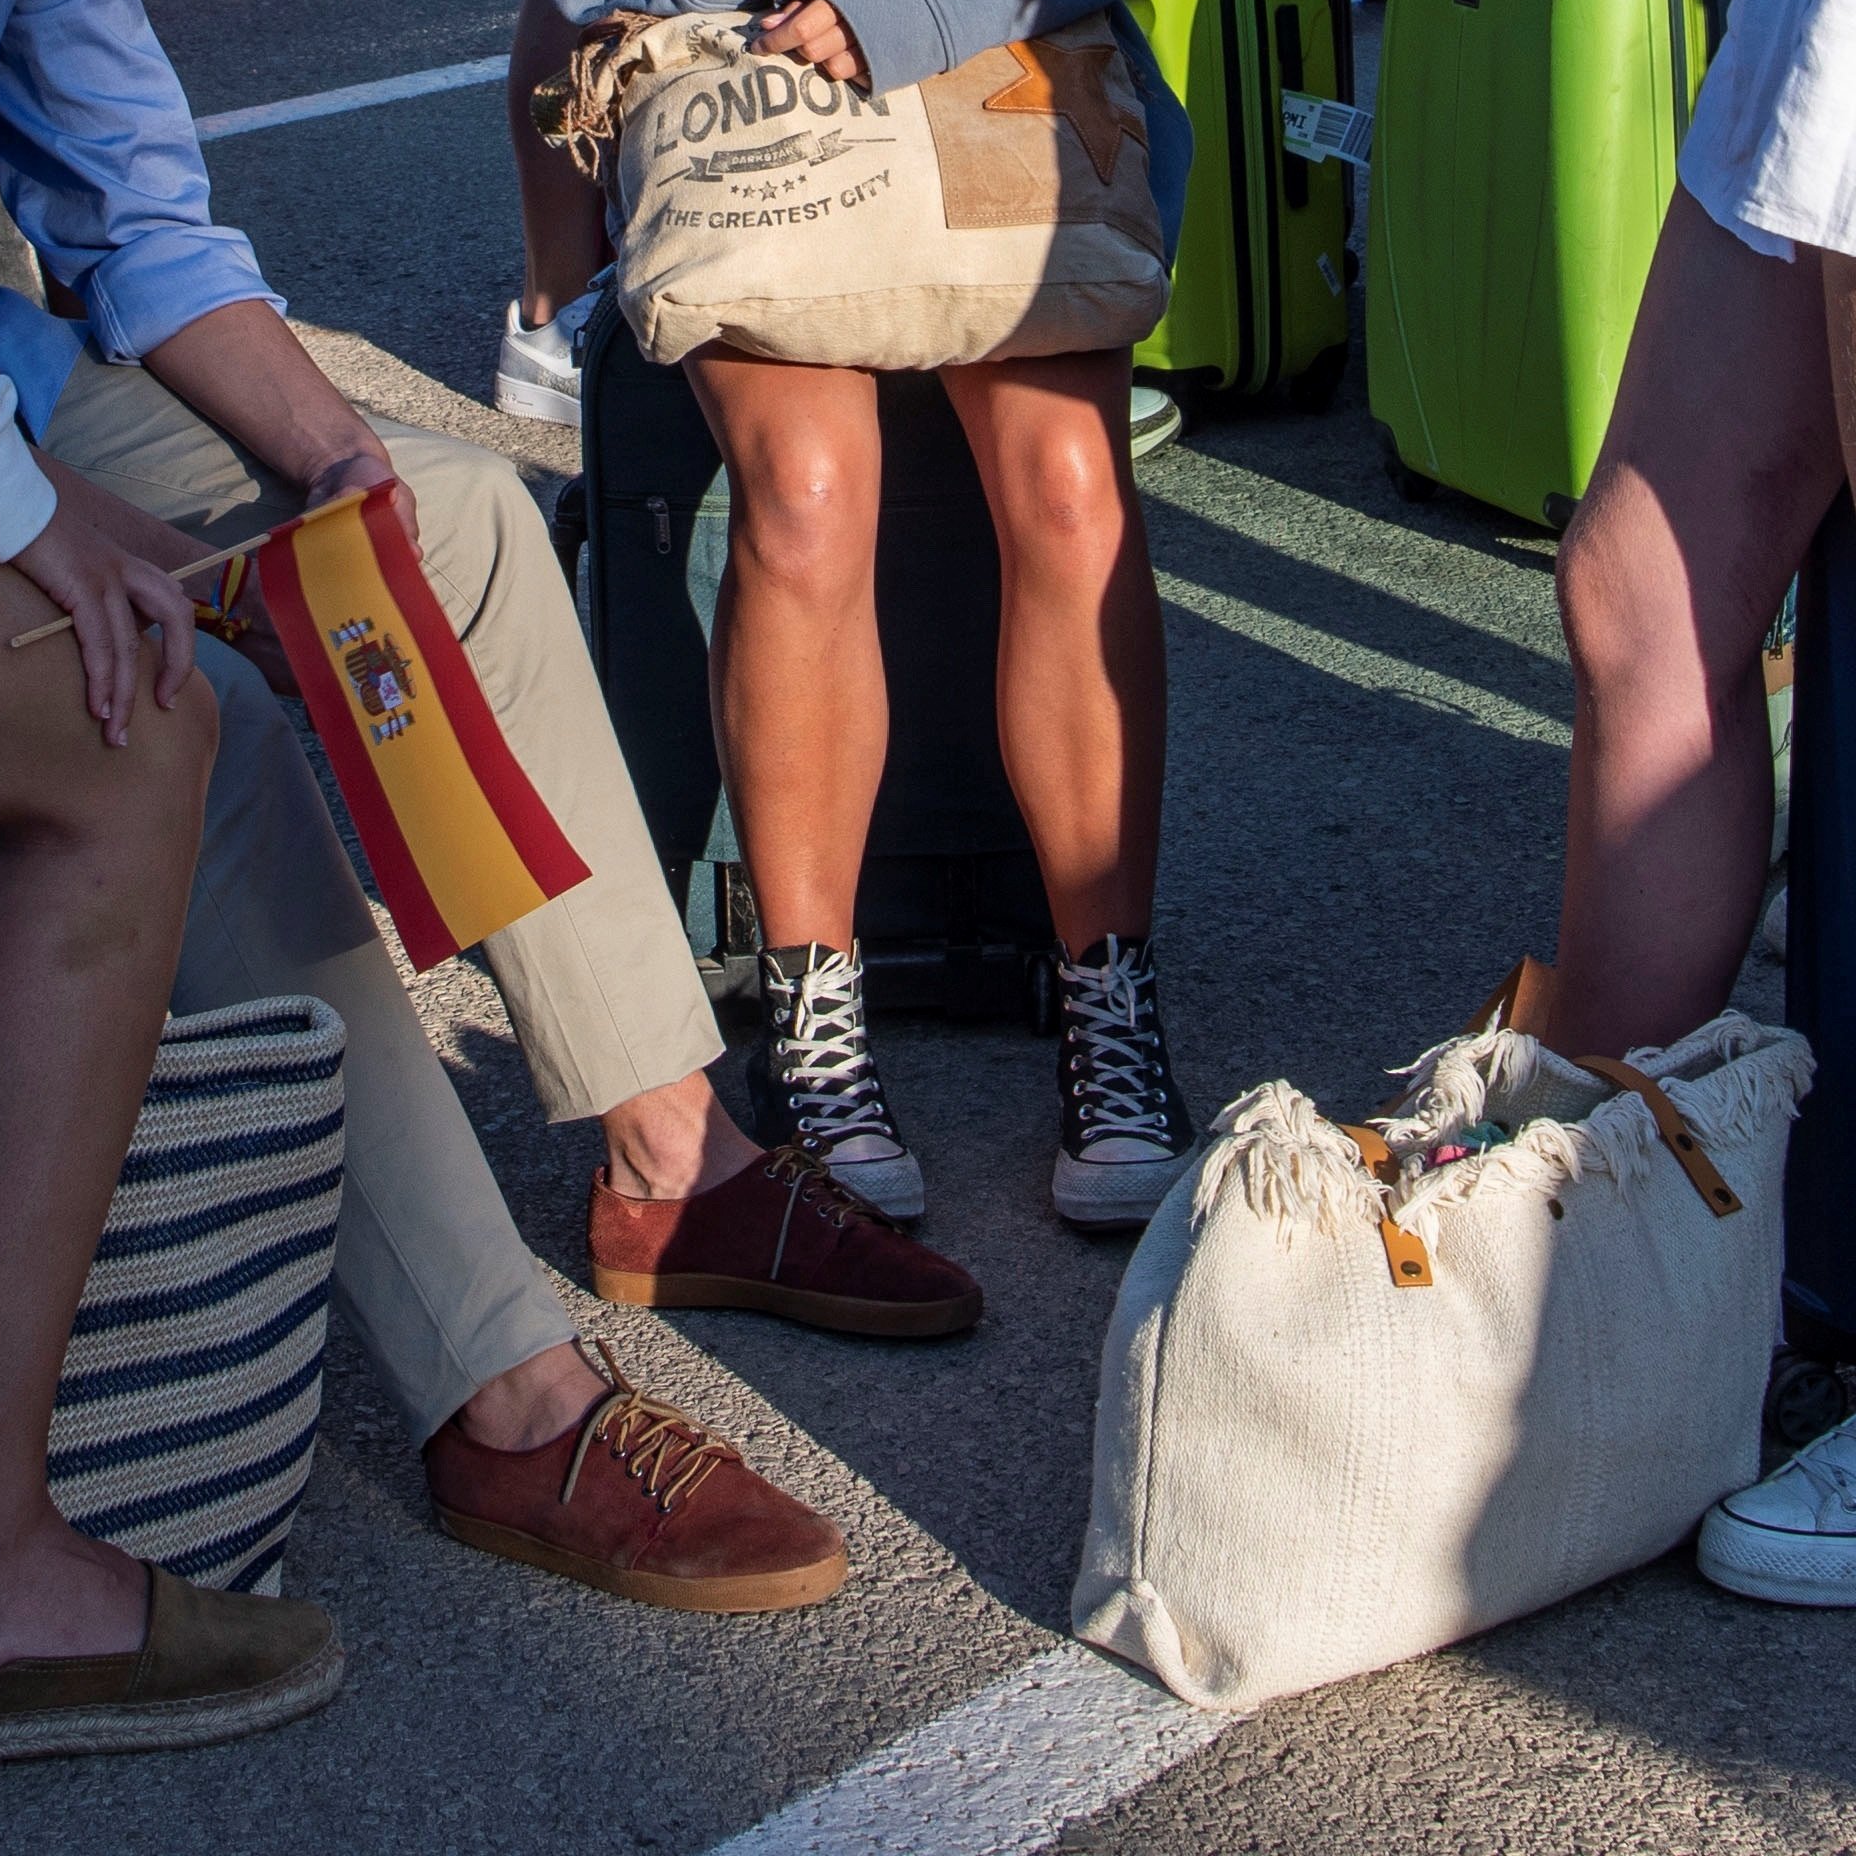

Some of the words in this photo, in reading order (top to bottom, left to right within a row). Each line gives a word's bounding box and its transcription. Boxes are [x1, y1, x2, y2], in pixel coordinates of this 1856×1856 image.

[665, 207, 703, 228] THE
[708, 197, 833, 230] GREATEST
[840, 169, 892, 209] CITY
